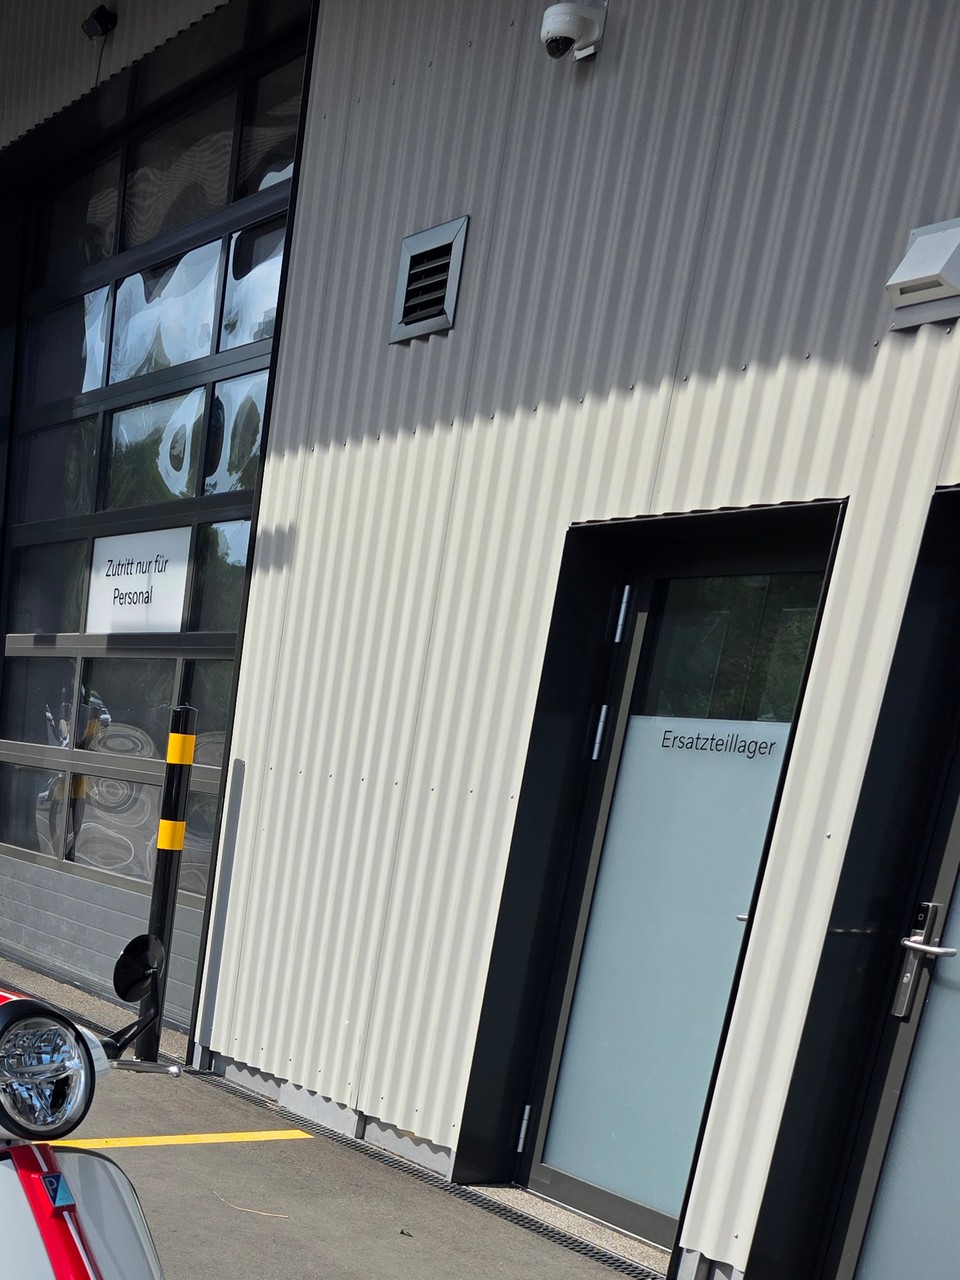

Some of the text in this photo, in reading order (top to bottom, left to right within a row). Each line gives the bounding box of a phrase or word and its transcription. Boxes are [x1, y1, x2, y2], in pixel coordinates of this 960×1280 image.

[105, 554, 169, 577] Zutritt nur für
[112, 585, 153, 606] Personal
[661, 730, 777, 760] Ersatzteillager
